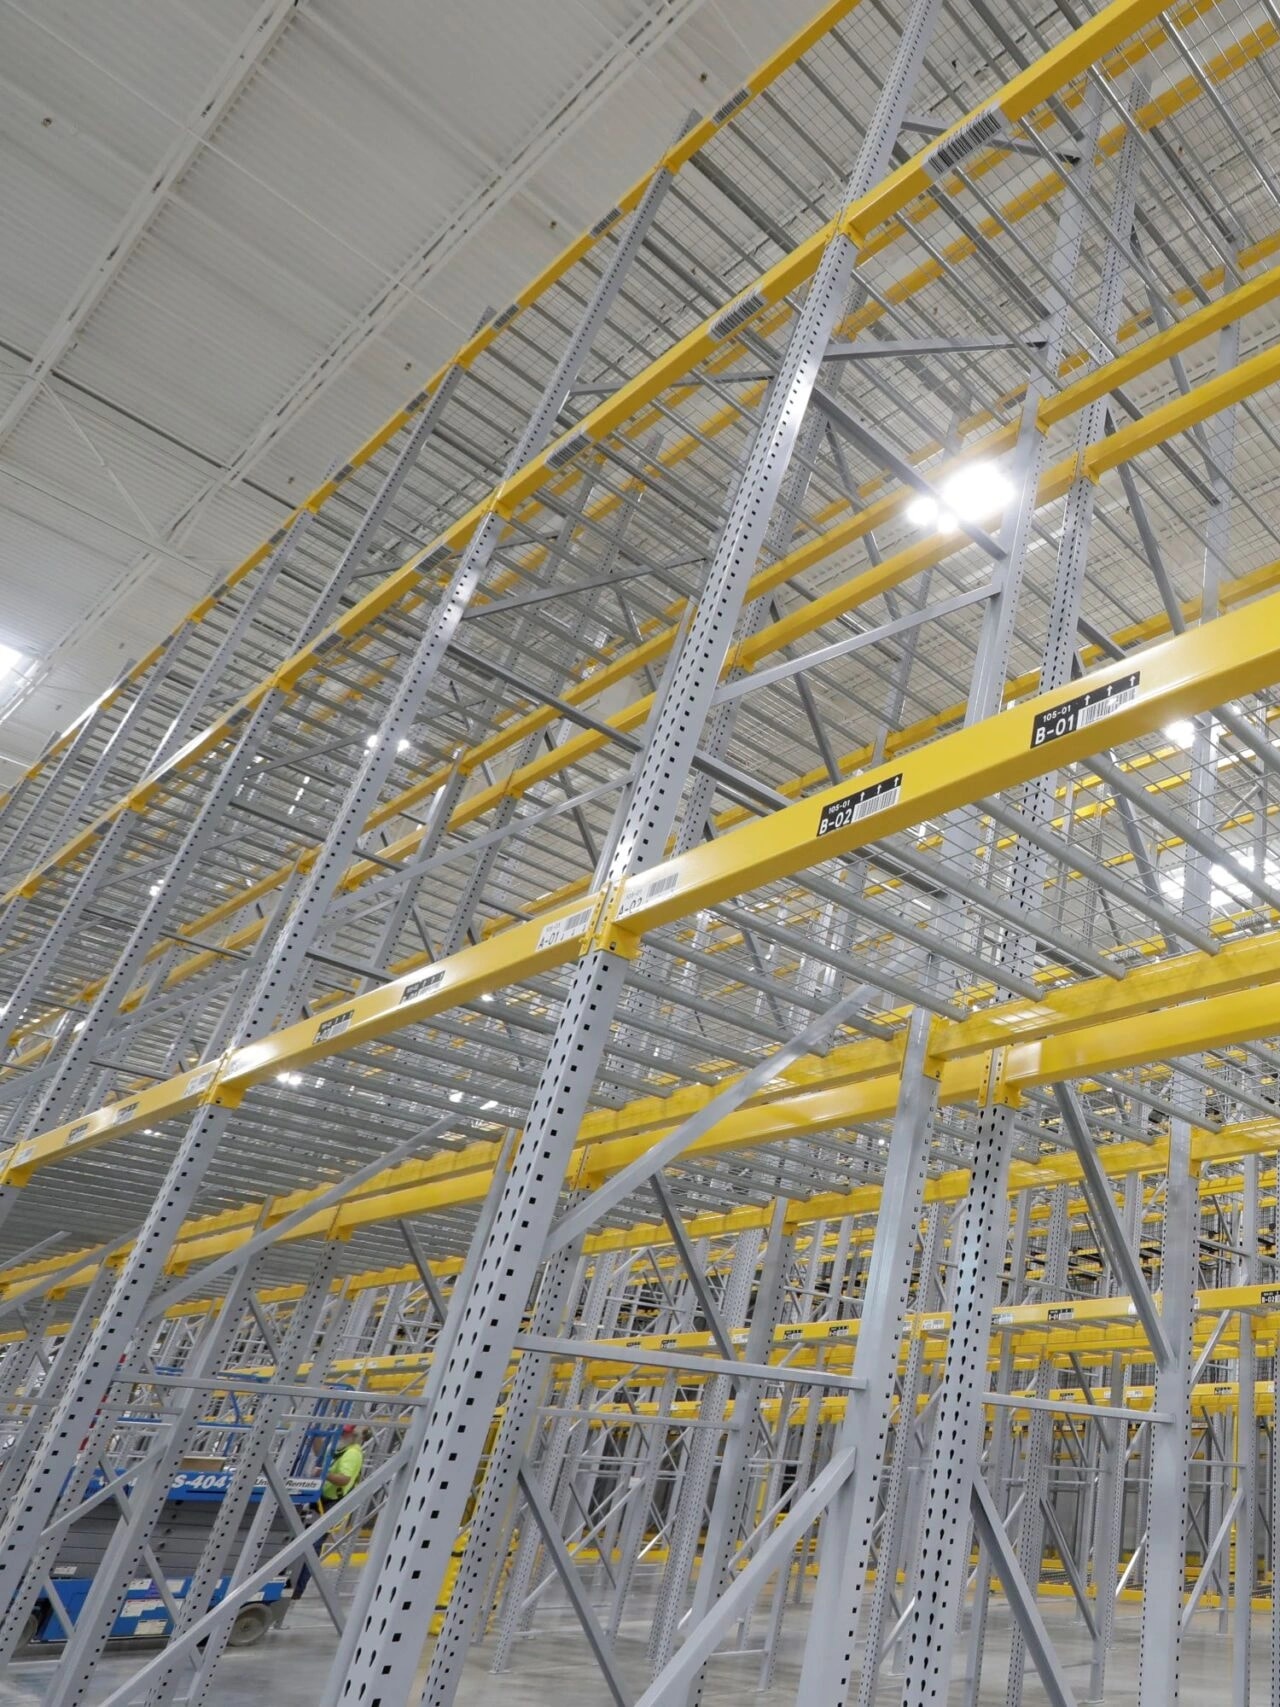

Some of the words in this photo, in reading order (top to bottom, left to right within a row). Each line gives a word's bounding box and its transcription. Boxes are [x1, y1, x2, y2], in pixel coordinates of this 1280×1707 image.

[1042, 705, 1071, 723] 105-01
[1034, 714, 1075, 745] B-01
[819, 808, 852, 835] B-02
[285, 1478, 318, 1489] Rentals
